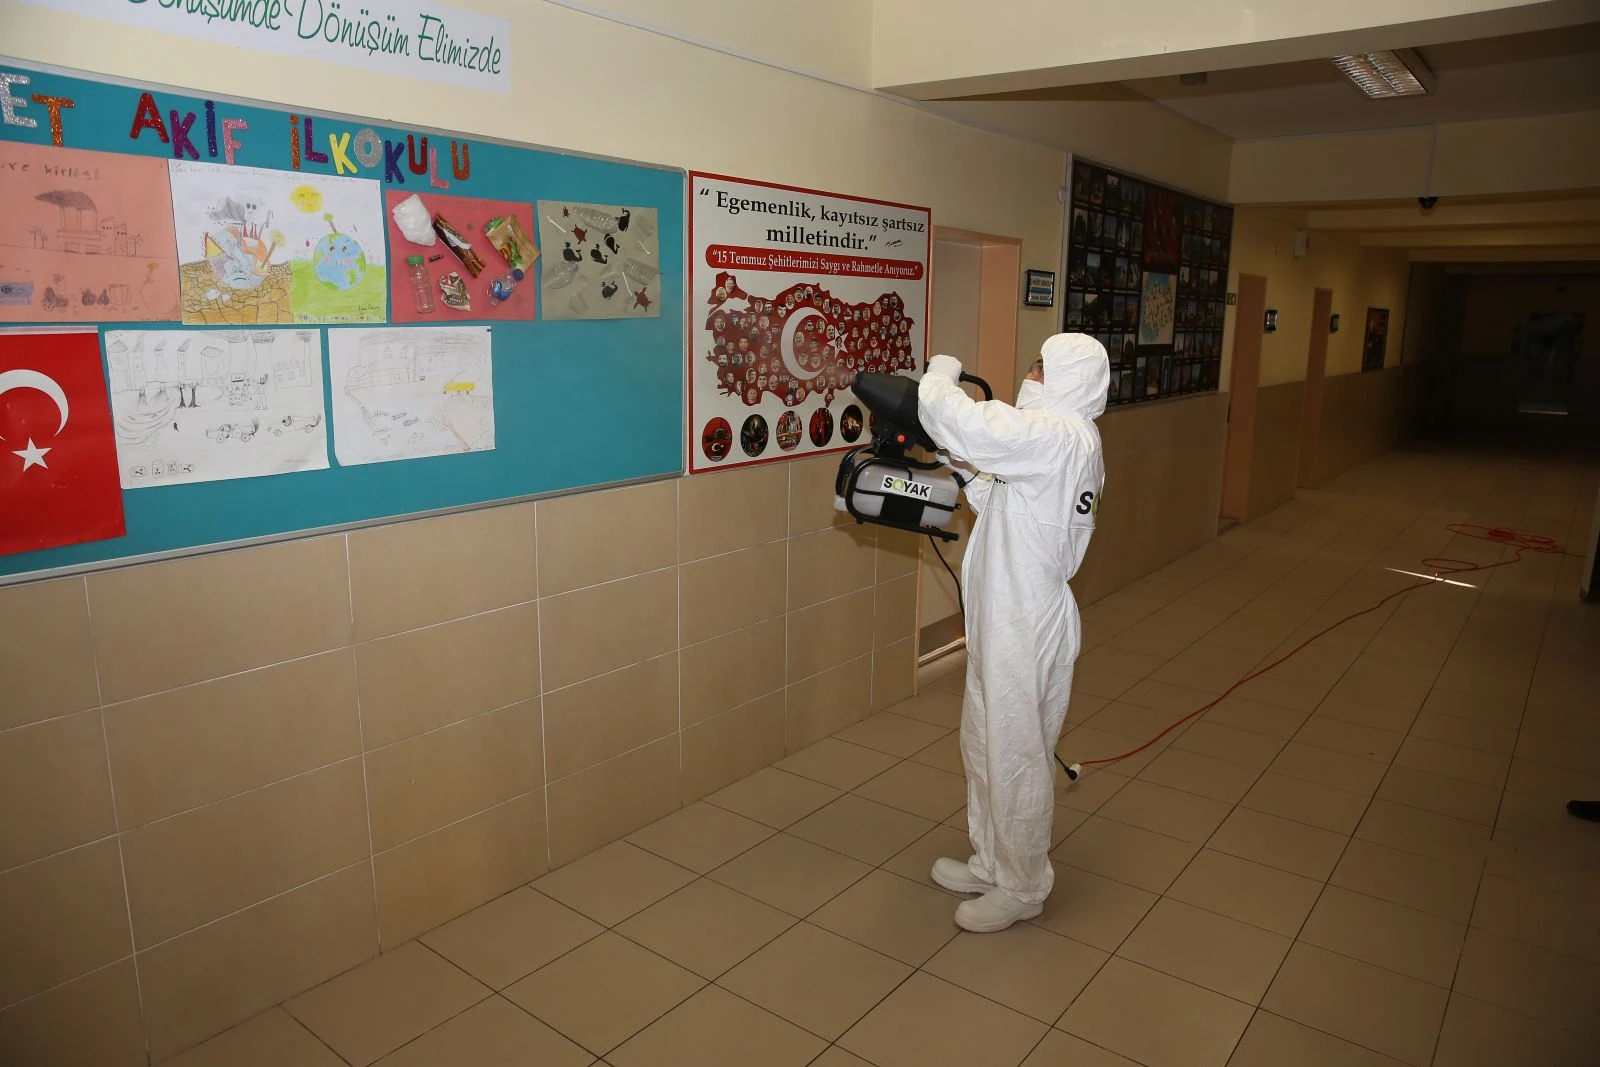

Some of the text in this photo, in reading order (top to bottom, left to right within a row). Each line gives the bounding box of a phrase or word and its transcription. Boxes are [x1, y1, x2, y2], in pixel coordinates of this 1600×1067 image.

[284, 0, 410, 56] Dönüşüm
[418, 13, 501, 74] Elimizde
[130, 92, 248, 165] AKİF
[289, 114, 470, 189] İLKOKULU
[716, 190, 815, 222] Egemenlik,
[820, 205, 879, 227] kayıtsız
[882, 217, 925, 233] şartsız
[729, 251, 767, 267] Temmuz
[768, 254, 819, 270] Şehitlerimizi
[820, 258, 840, 274] Saygı
[842, 263, 851, 272] ve
[851, 260, 883, 274] Rahmetle
[883, 476, 931, 498] SOYAK
